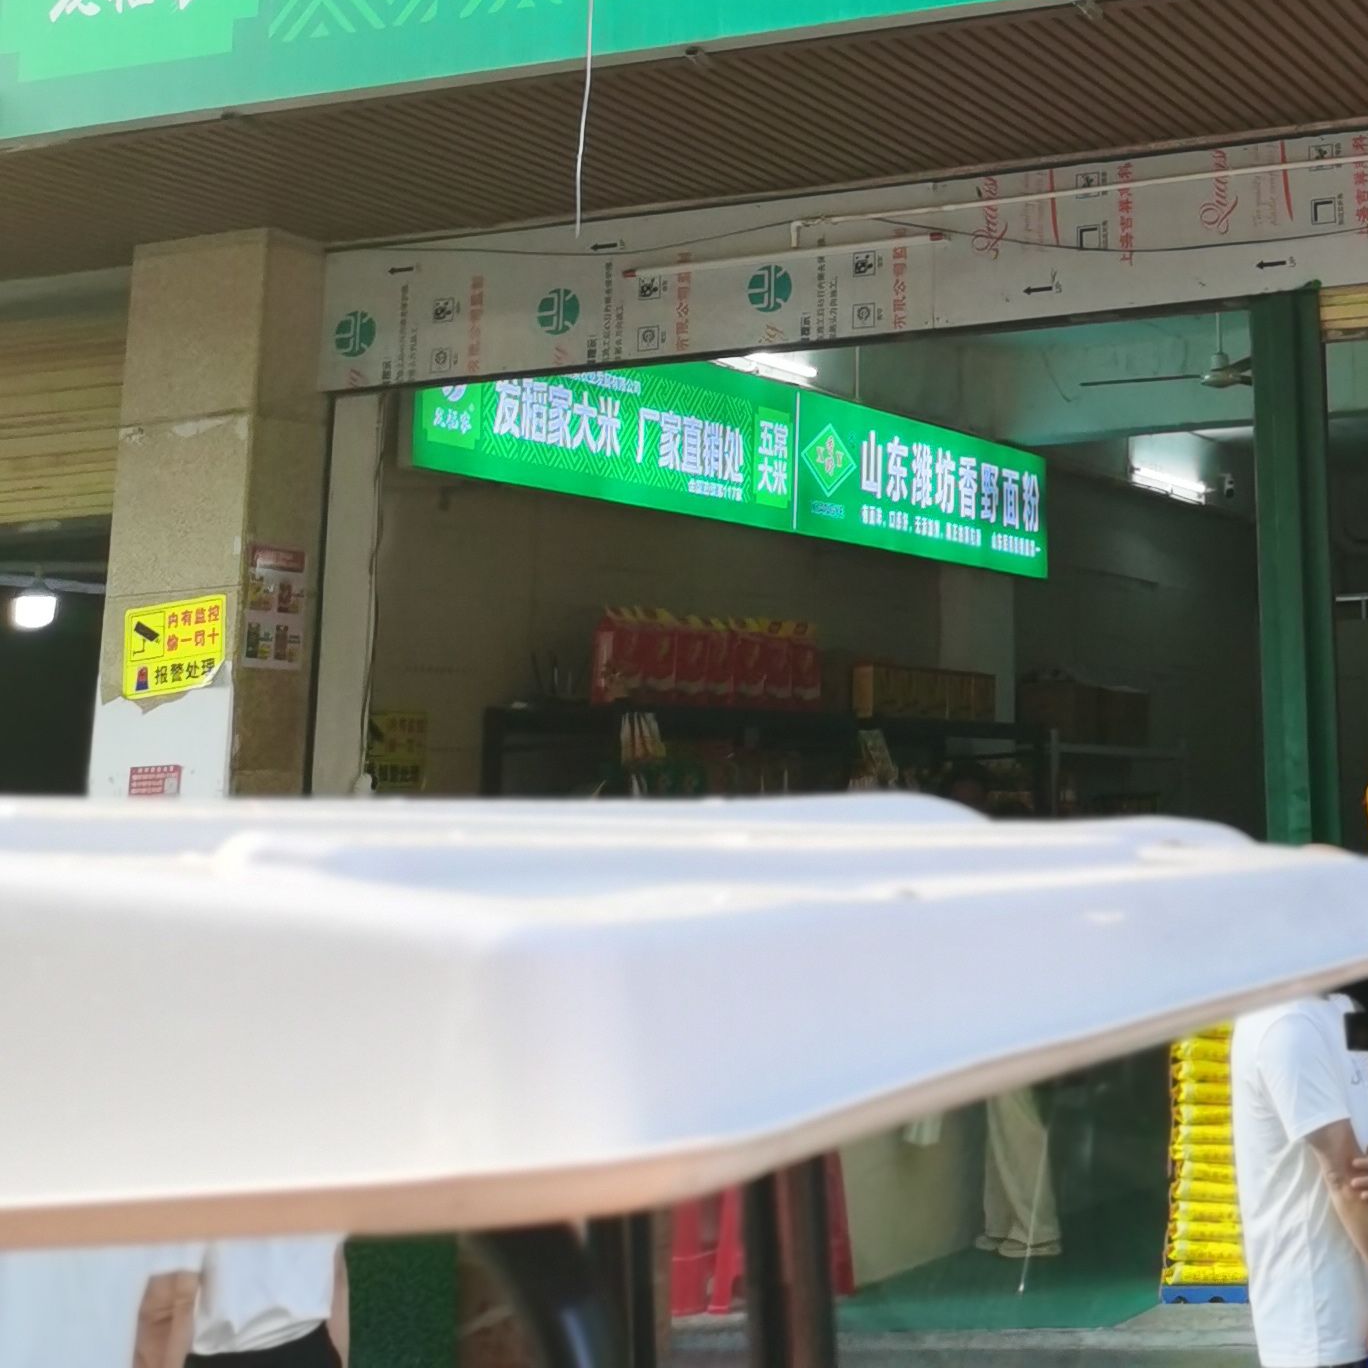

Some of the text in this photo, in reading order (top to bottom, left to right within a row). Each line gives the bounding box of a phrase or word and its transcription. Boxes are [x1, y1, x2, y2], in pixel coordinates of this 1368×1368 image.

[636, 407, 744, 483] 厂家直销处
[758, 420, 788, 460] 五常
[757, 458, 787, 495] 大米
[861, 430, 1040, 532] 山东潍坊香野面粉
[168, 605, 219, 628] 内有监控
